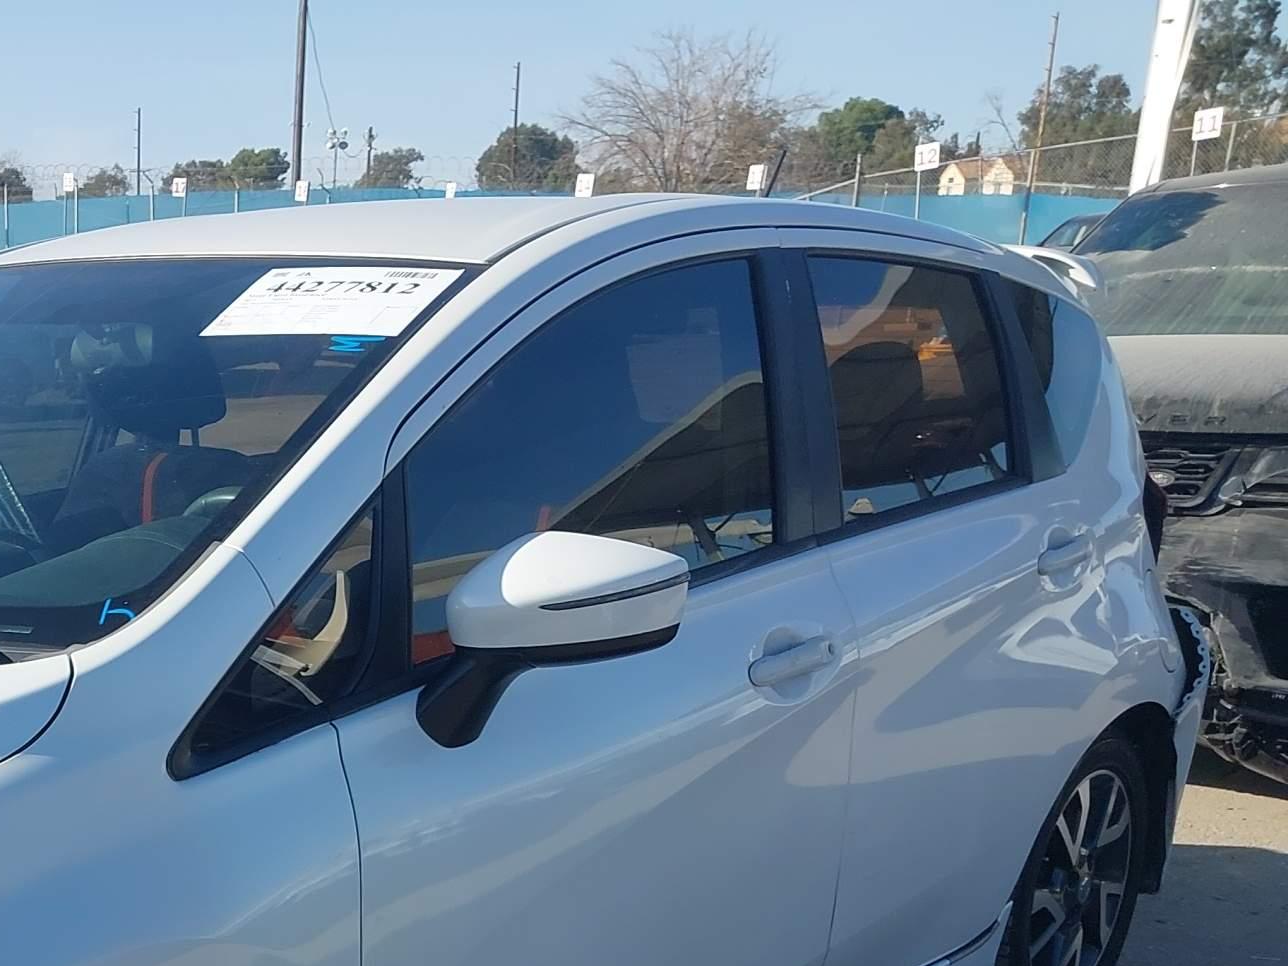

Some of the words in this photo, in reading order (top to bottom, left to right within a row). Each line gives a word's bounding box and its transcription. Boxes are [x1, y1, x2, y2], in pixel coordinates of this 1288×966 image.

[1195, 115, 1217, 135] 11
[917, 148, 937, 166] 12
[174, 181, 186, 194] 17
[266, 280, 422, 295] 44277812
